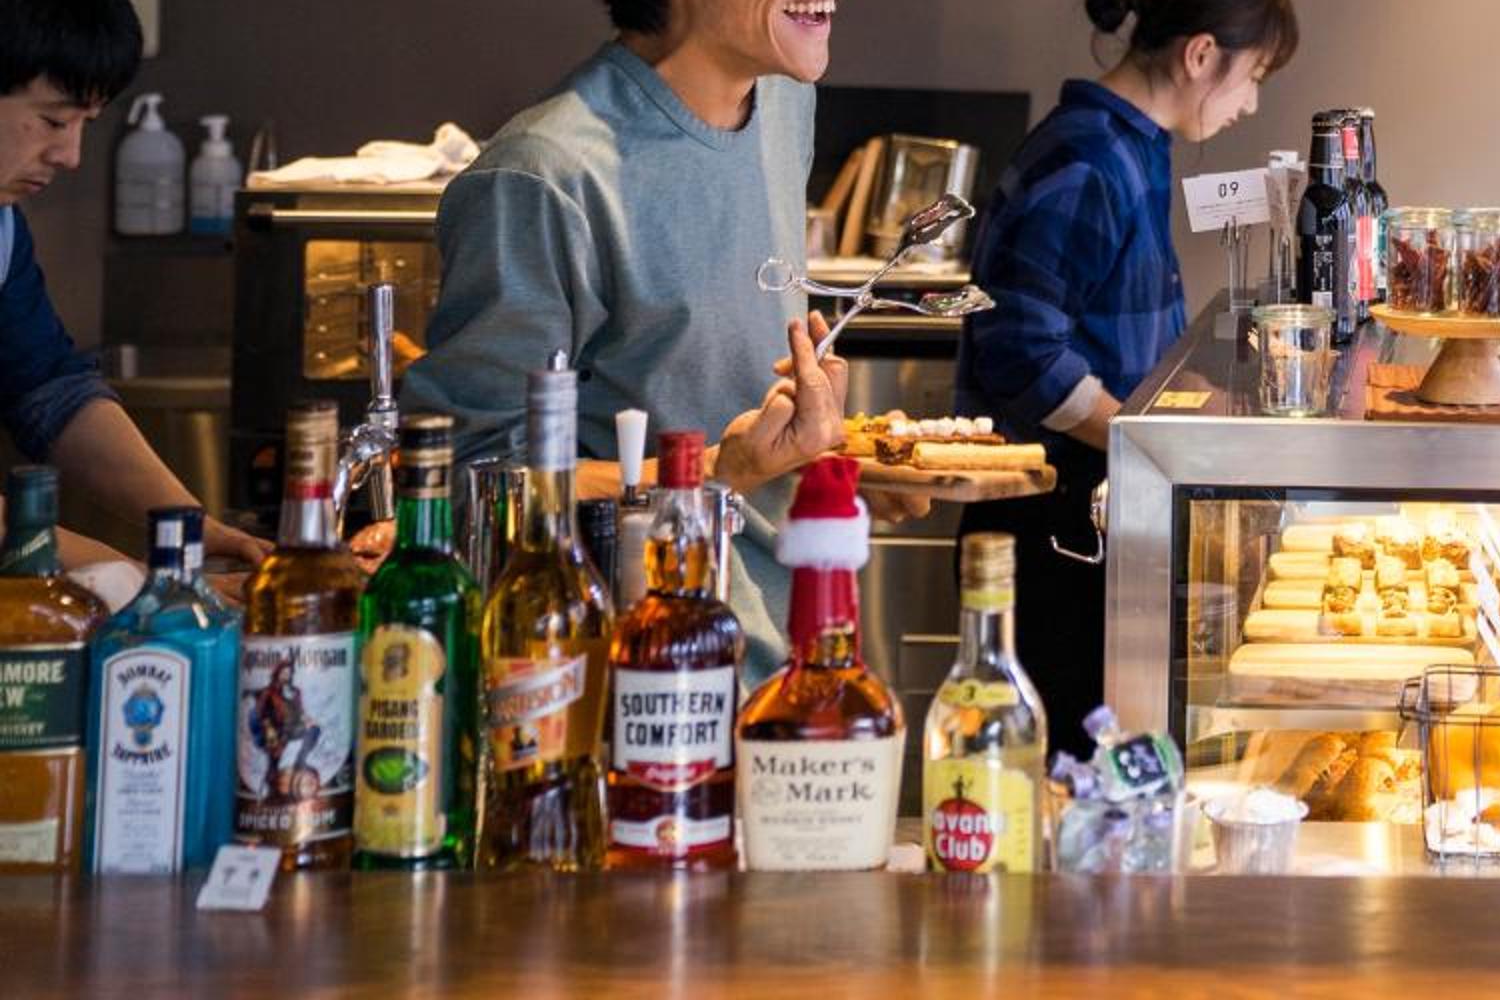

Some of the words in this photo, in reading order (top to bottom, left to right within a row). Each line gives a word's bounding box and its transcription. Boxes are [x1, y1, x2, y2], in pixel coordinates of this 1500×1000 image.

[1218, 181, 1239, 198] 09
[0, 660, 65, 684] MORE
[116, 664, 172, 687] BOMBAY
[621, 691, 727, 717] SOUTHERN
[625, 720, 719, 746] COMFORT
[112, 743, 172, 765] SAPPHIRE
[752, 755, 876, 776] Maker's
[786, 781, 875, 802] Mark
[936, 833, 986, 862] Club
